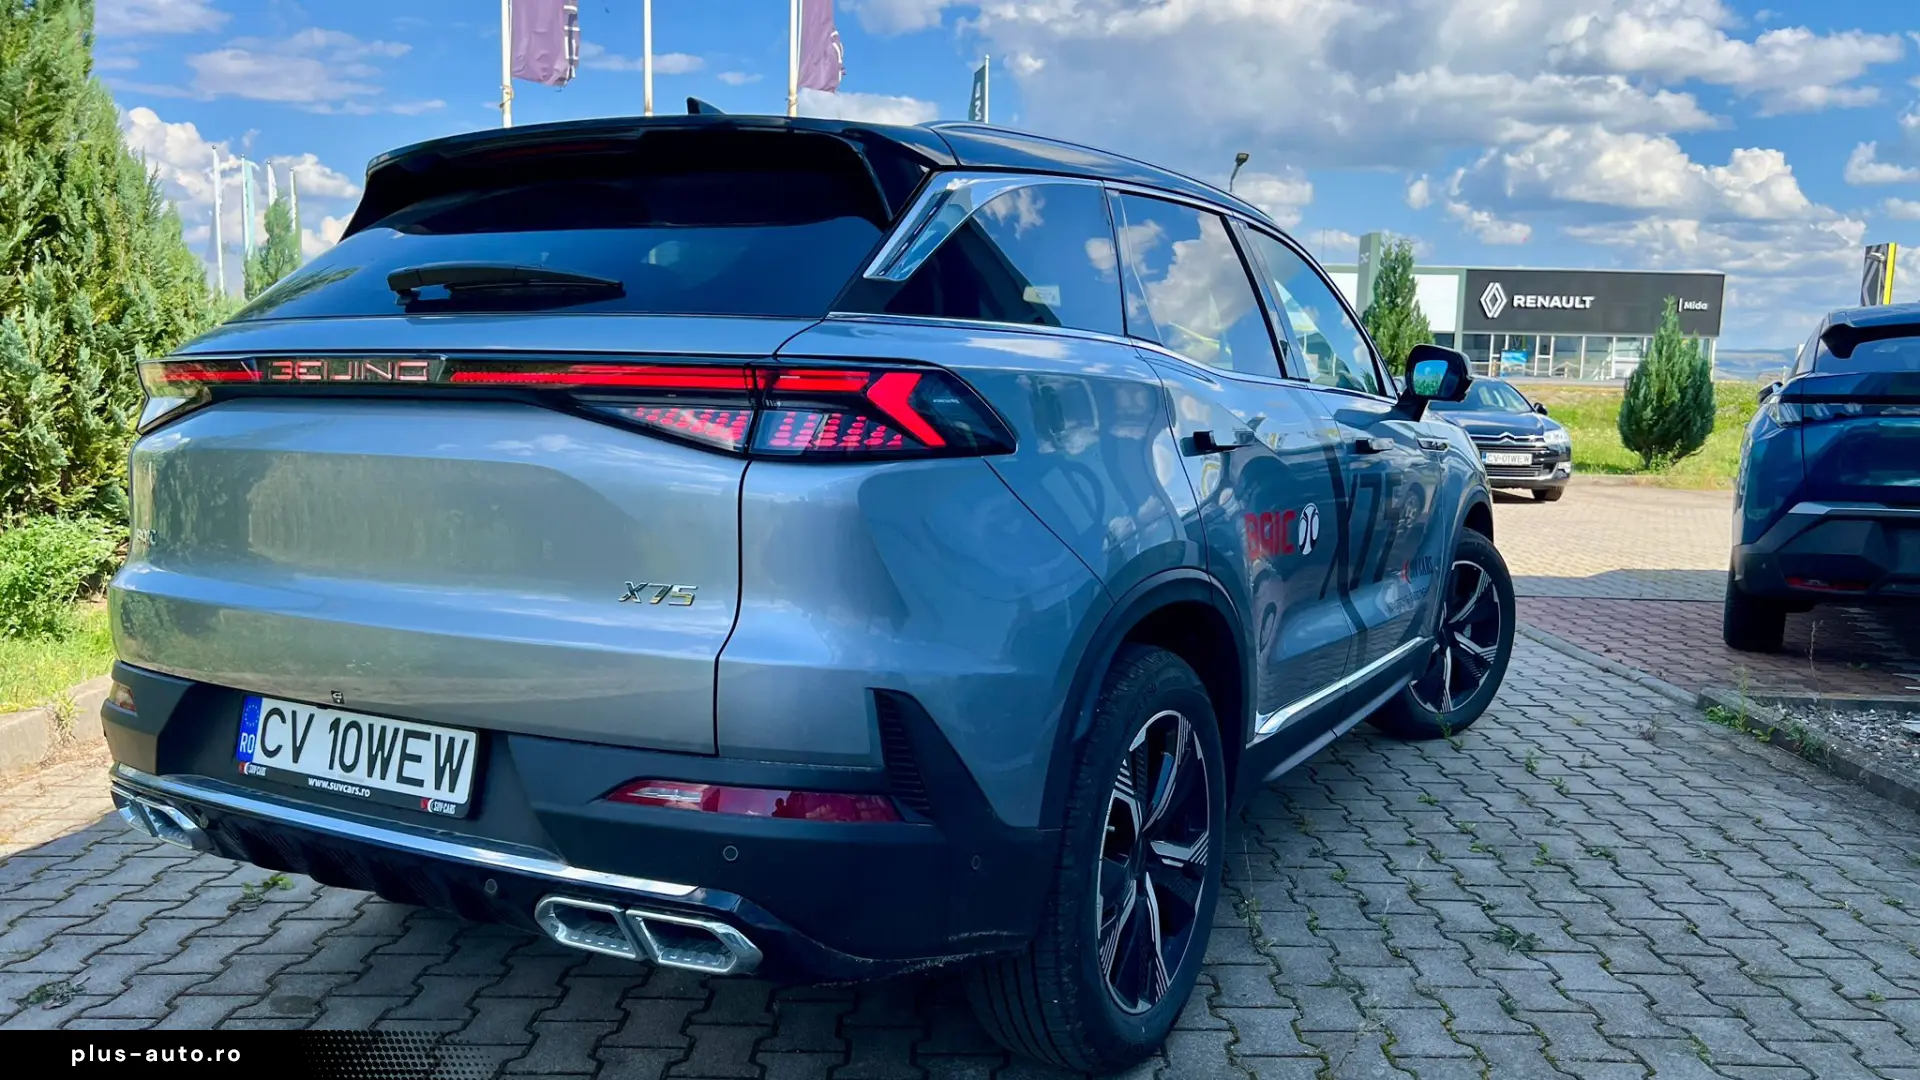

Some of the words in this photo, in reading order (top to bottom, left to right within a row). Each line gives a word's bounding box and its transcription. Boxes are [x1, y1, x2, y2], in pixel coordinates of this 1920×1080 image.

[1513, 295, 1595, 309] RENAULT
[1684, 301, 1708, 311] Mida
[268, 360, 428, 382] BEIJING
[617, 580, 699, 606] X75
[239, 732, 256, 754] RO
[260, 707, 316, 764] CV
[328, 716, 470, 794] 10WEW
[307, 777, 371, 798] www.suvcars.ro
